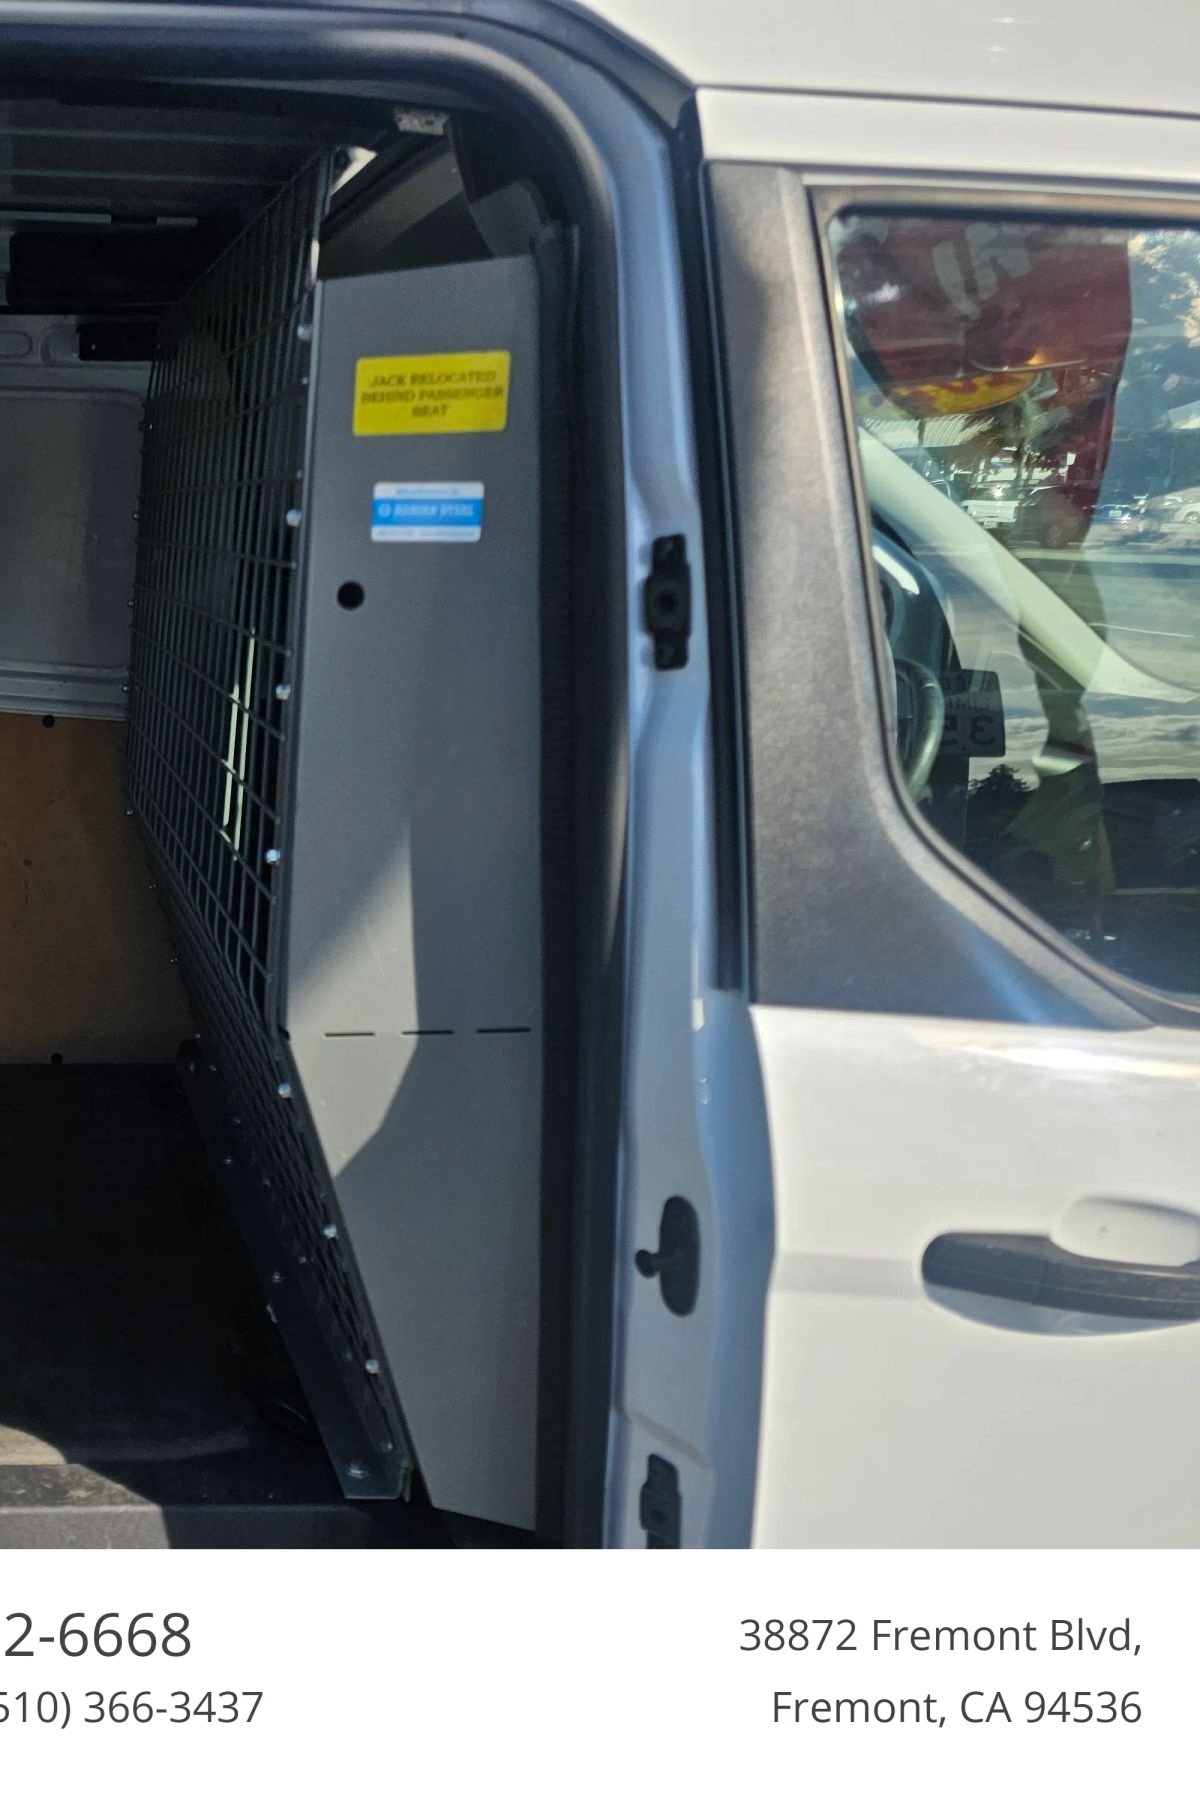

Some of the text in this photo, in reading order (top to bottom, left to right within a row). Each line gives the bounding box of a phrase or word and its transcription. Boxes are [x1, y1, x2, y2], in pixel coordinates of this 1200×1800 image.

[369, 371, 498, 387] JACK RELOCATED
[360, 385, 505, 405] BEHIND PASSENGER
[412, 404, 450, 419] SEAT
